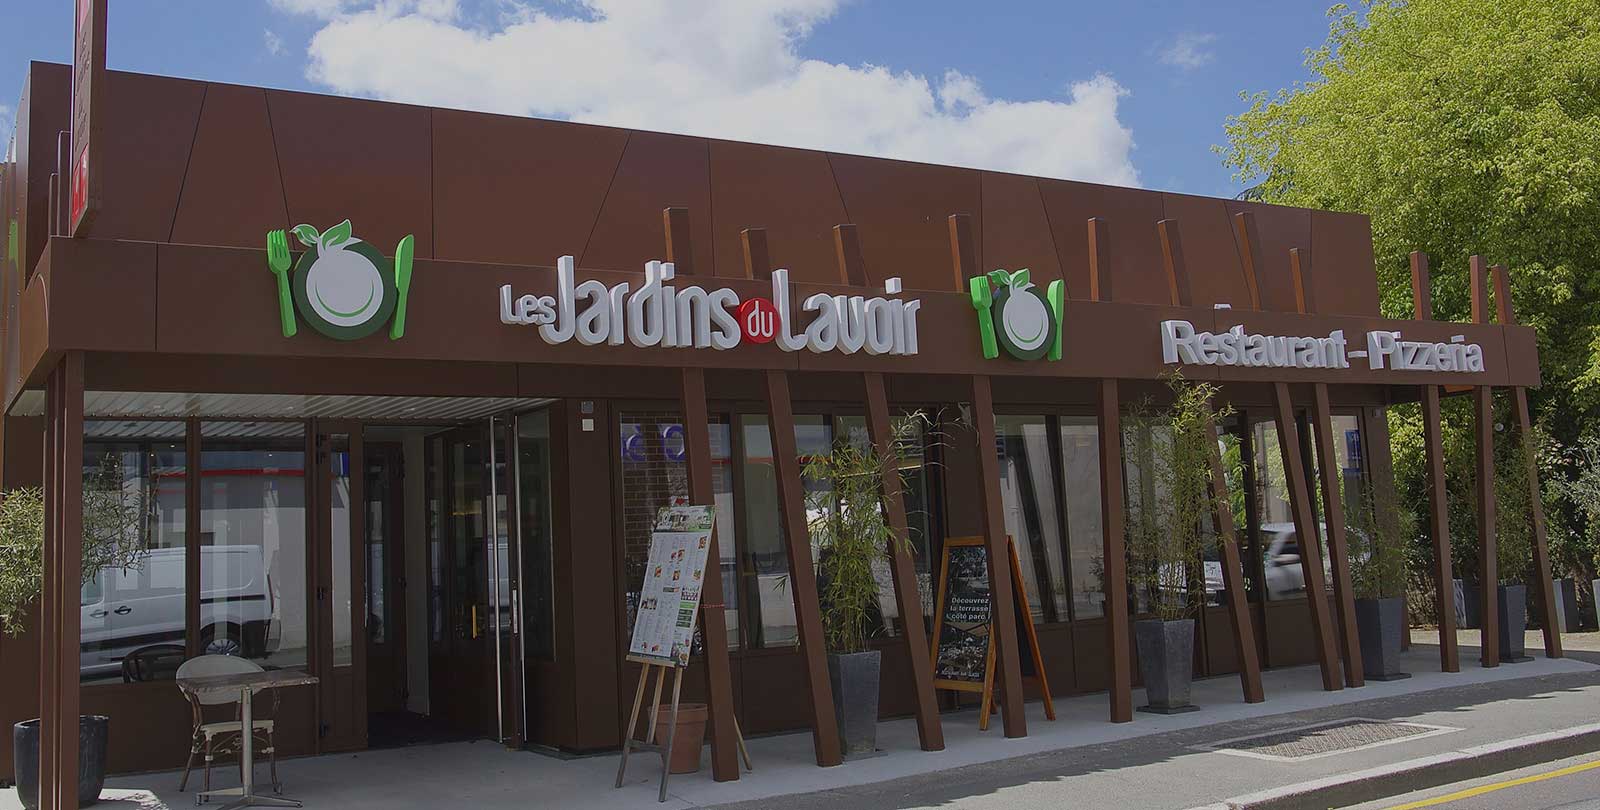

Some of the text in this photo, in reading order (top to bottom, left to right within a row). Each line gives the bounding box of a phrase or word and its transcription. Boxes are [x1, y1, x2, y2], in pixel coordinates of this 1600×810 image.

[500, 255, 921, 356] Les Jardins du Lavoir
[1161, 319, 1350, 369] Restaurant
[1366, 330, 1485, 372] Pizzeria
[951, 596, 989, 604] Découvrez
